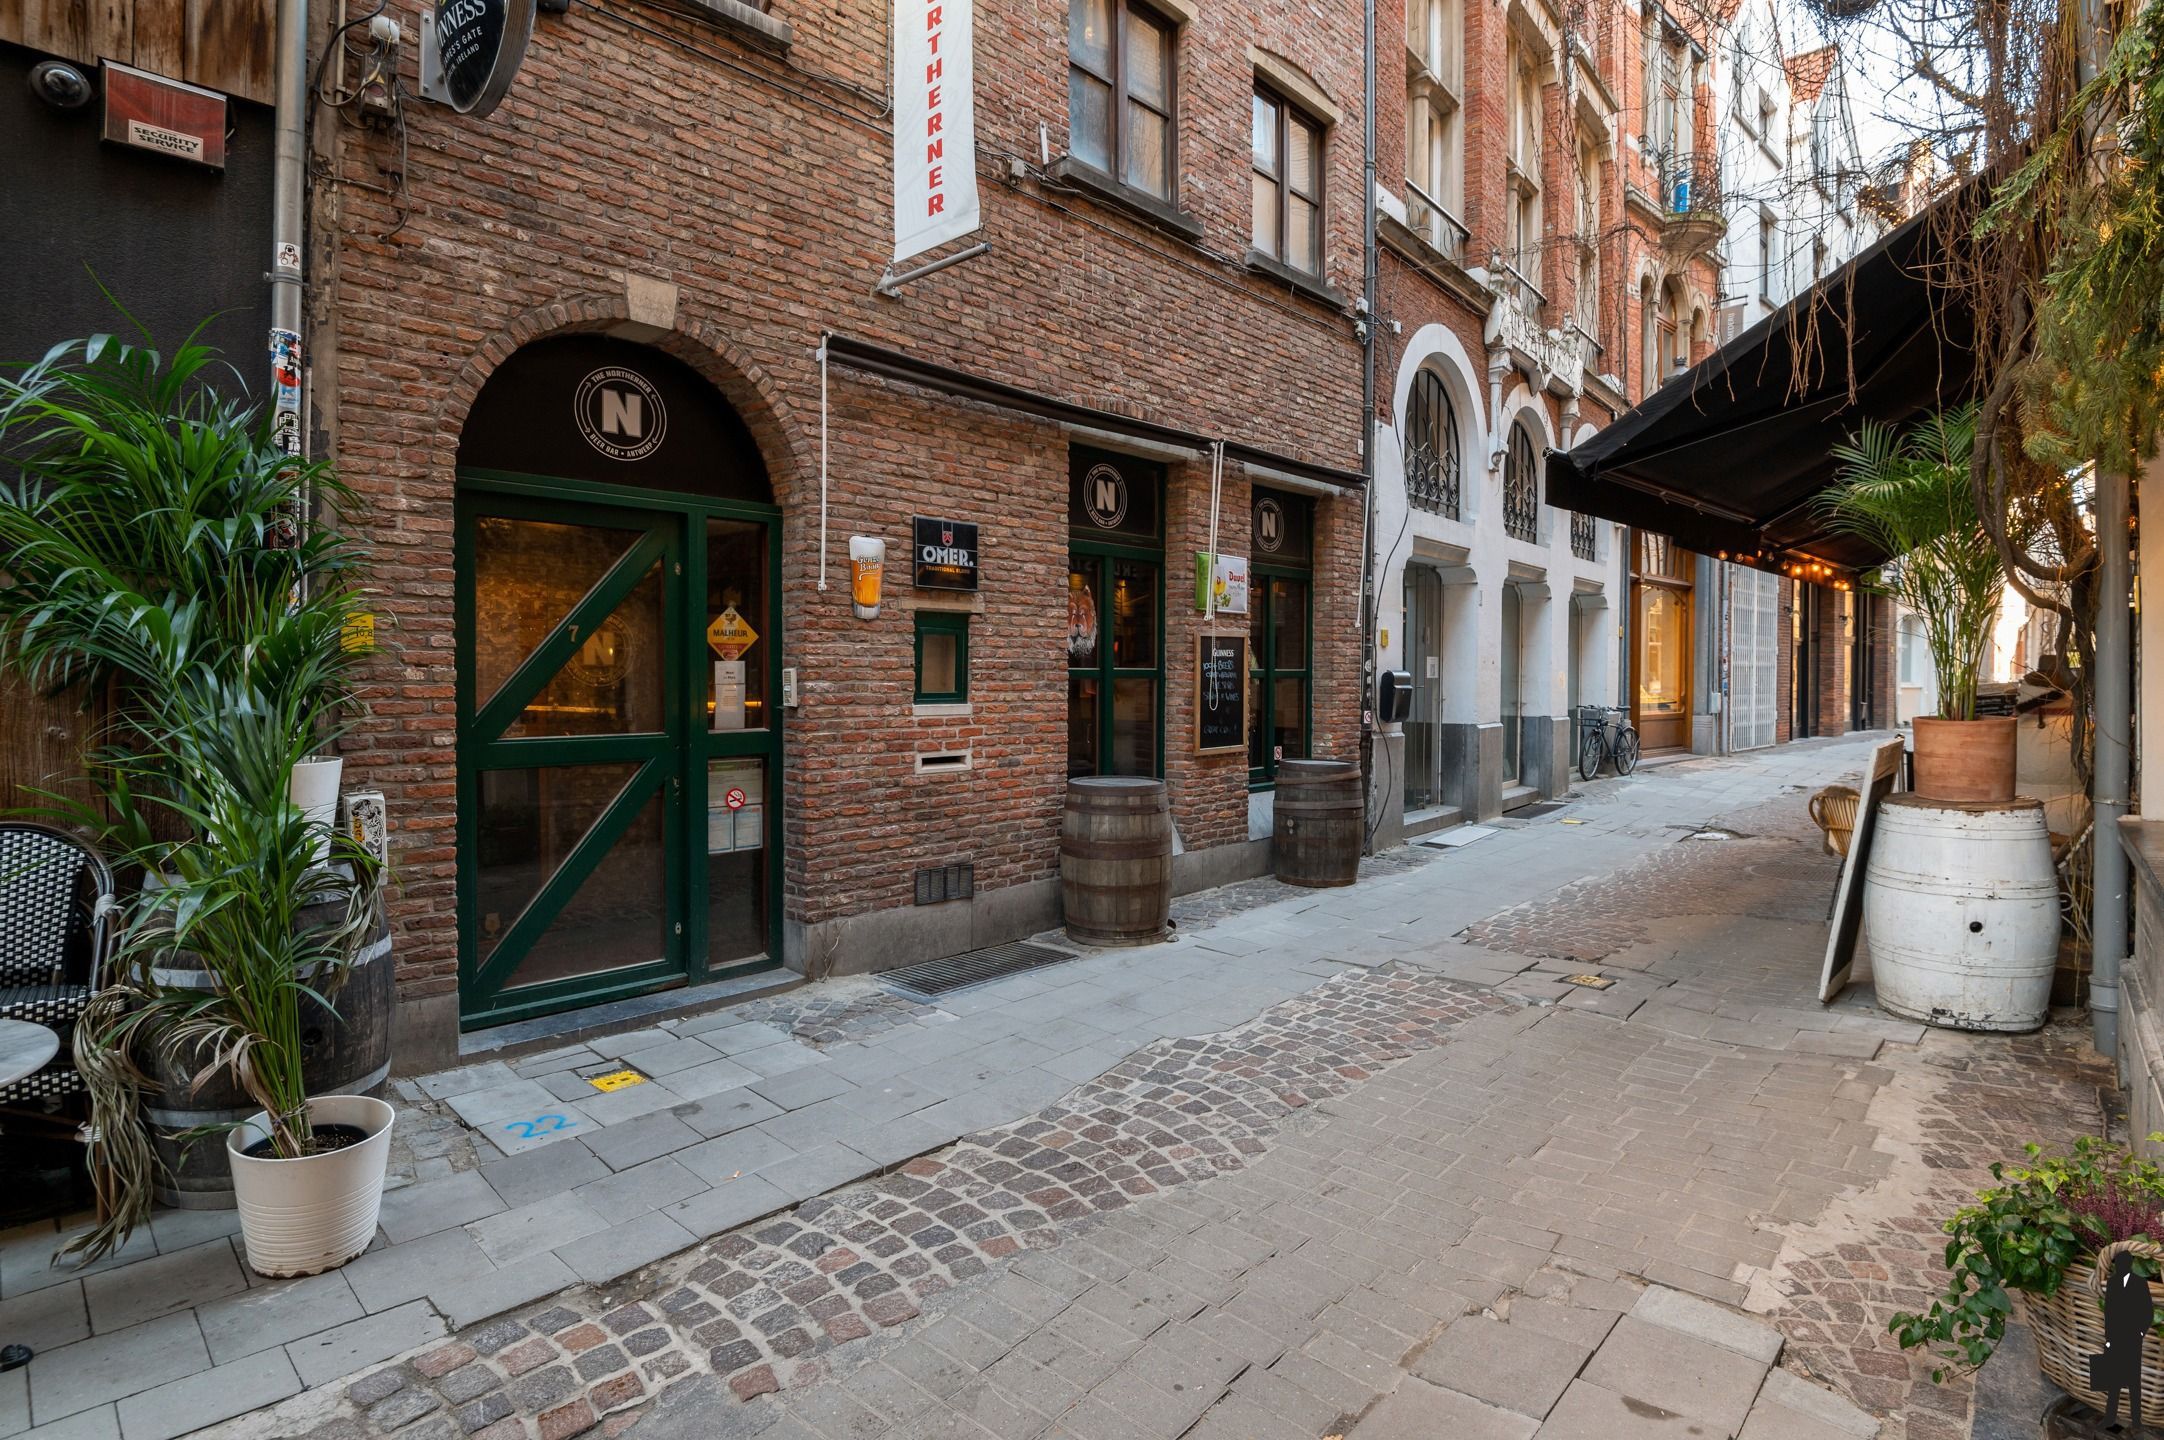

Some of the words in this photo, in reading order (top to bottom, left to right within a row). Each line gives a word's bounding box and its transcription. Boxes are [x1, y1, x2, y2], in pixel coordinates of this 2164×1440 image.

[437, 0, 486, 47] INNESS
[444, 40, 461, 64] AMES'S
[462, 26, 482, 44] GATE
[456, 43, 480, 65] IRELAND
[926, 0, 944, 217] RTHERNER
[134, 127, 199, 148] SECURITY
[139, 135, 194, 153] SERVICE
[591, 370, 606, 383] THE
[605, 369, 652, 394] NORTHERNER
[601, 387, 642, 438] N
[589, 433, 606, 449] BEER
[606, 444, 619, 456] BAR
[626, 441, 653, 457] ANTWERP
[1096, 479, 1116, 512] N
[1261, 511, 1276, 538] N
[567, 624, 580, 643] 7
[713, 629, 748, 638] MALHEUR
[504, 1114, 578, 1138] 22
